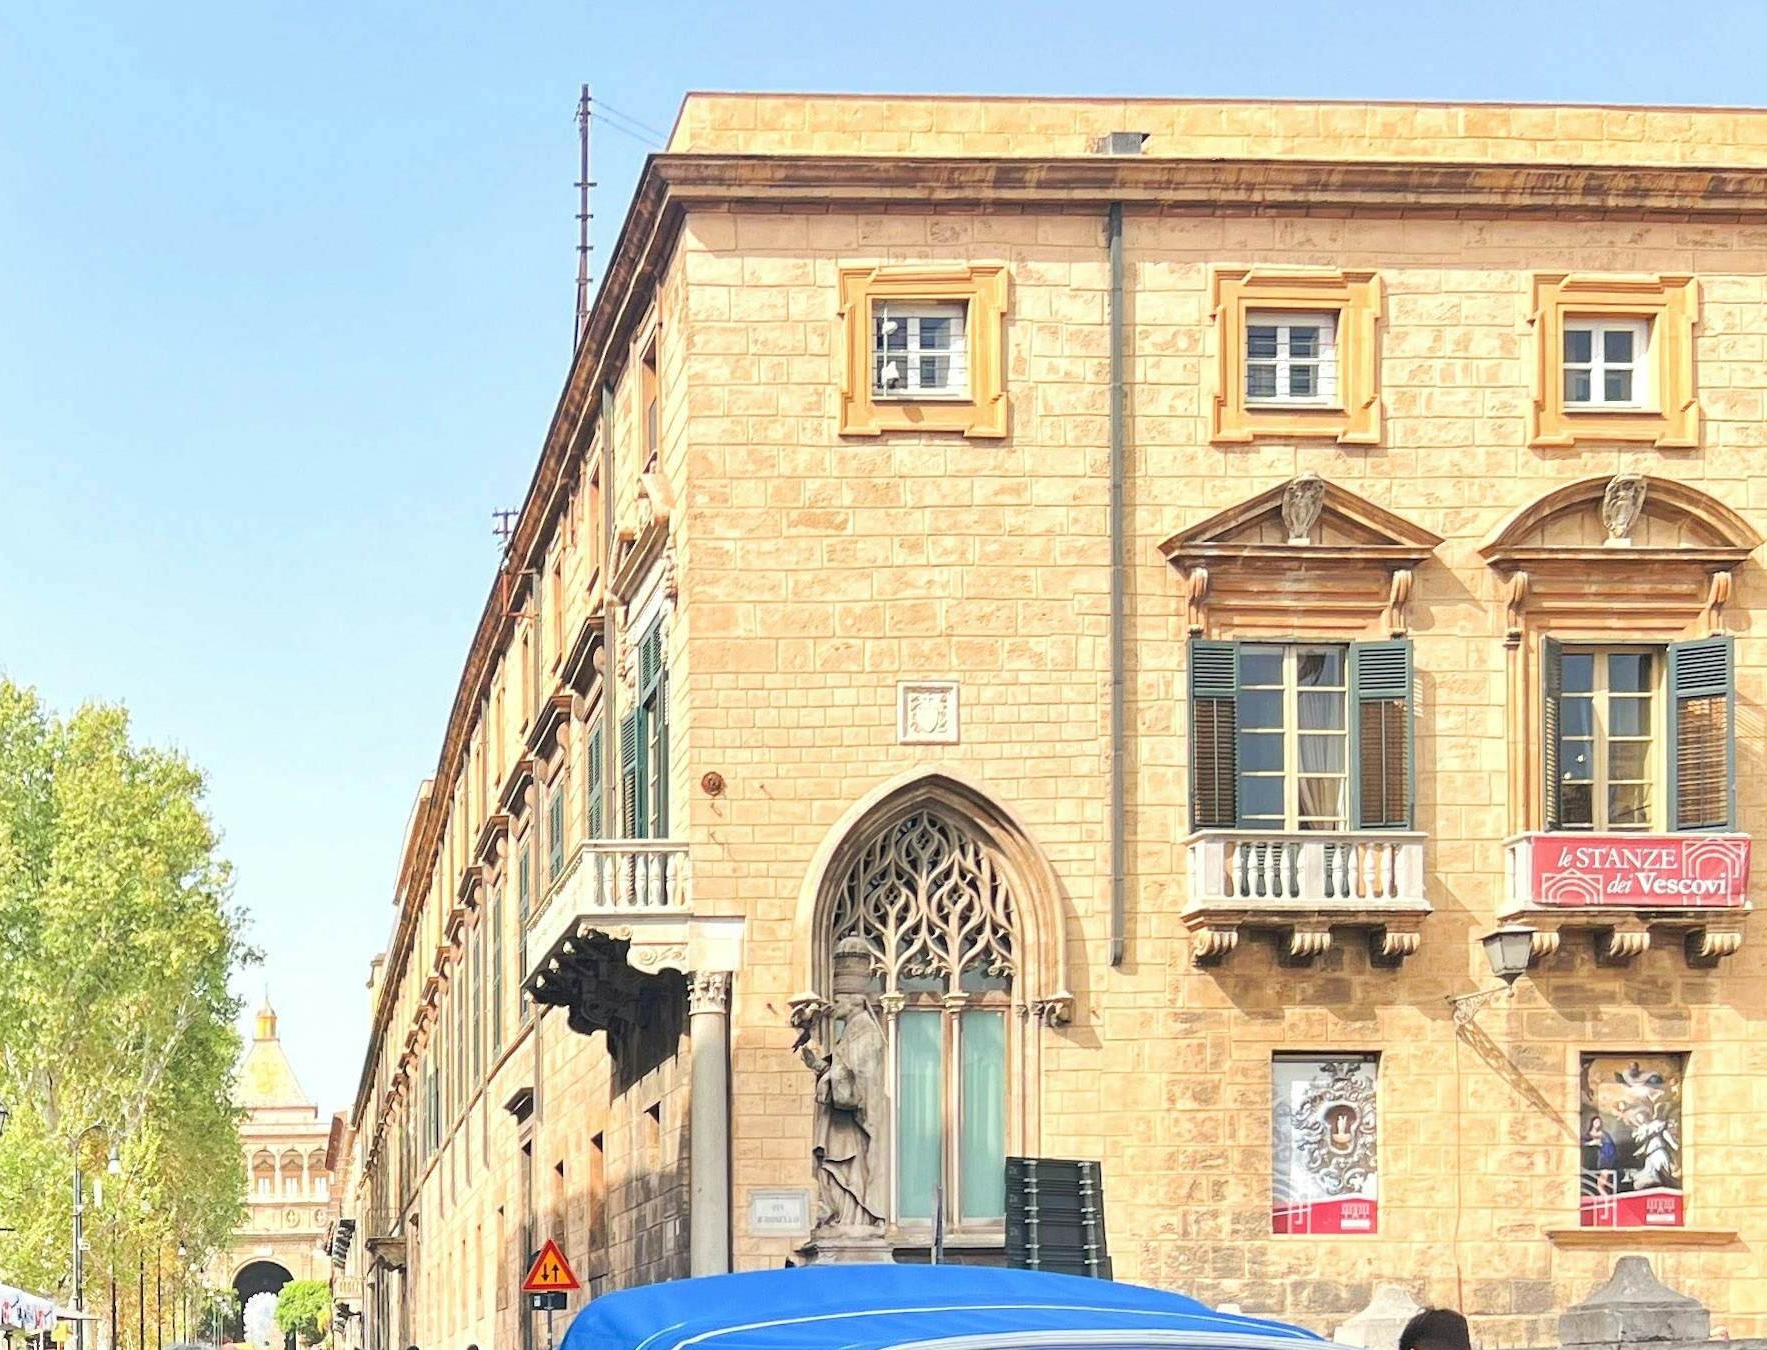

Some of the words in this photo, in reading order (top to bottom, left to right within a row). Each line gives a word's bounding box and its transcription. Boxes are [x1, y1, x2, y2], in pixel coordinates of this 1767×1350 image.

[1558, 847, 1572, 867] le
[1576, 847, 1678, 869] STANZE
[1606, 873, 1632, 893] dei
[1635, 872, 1727, 895] Vescovi
